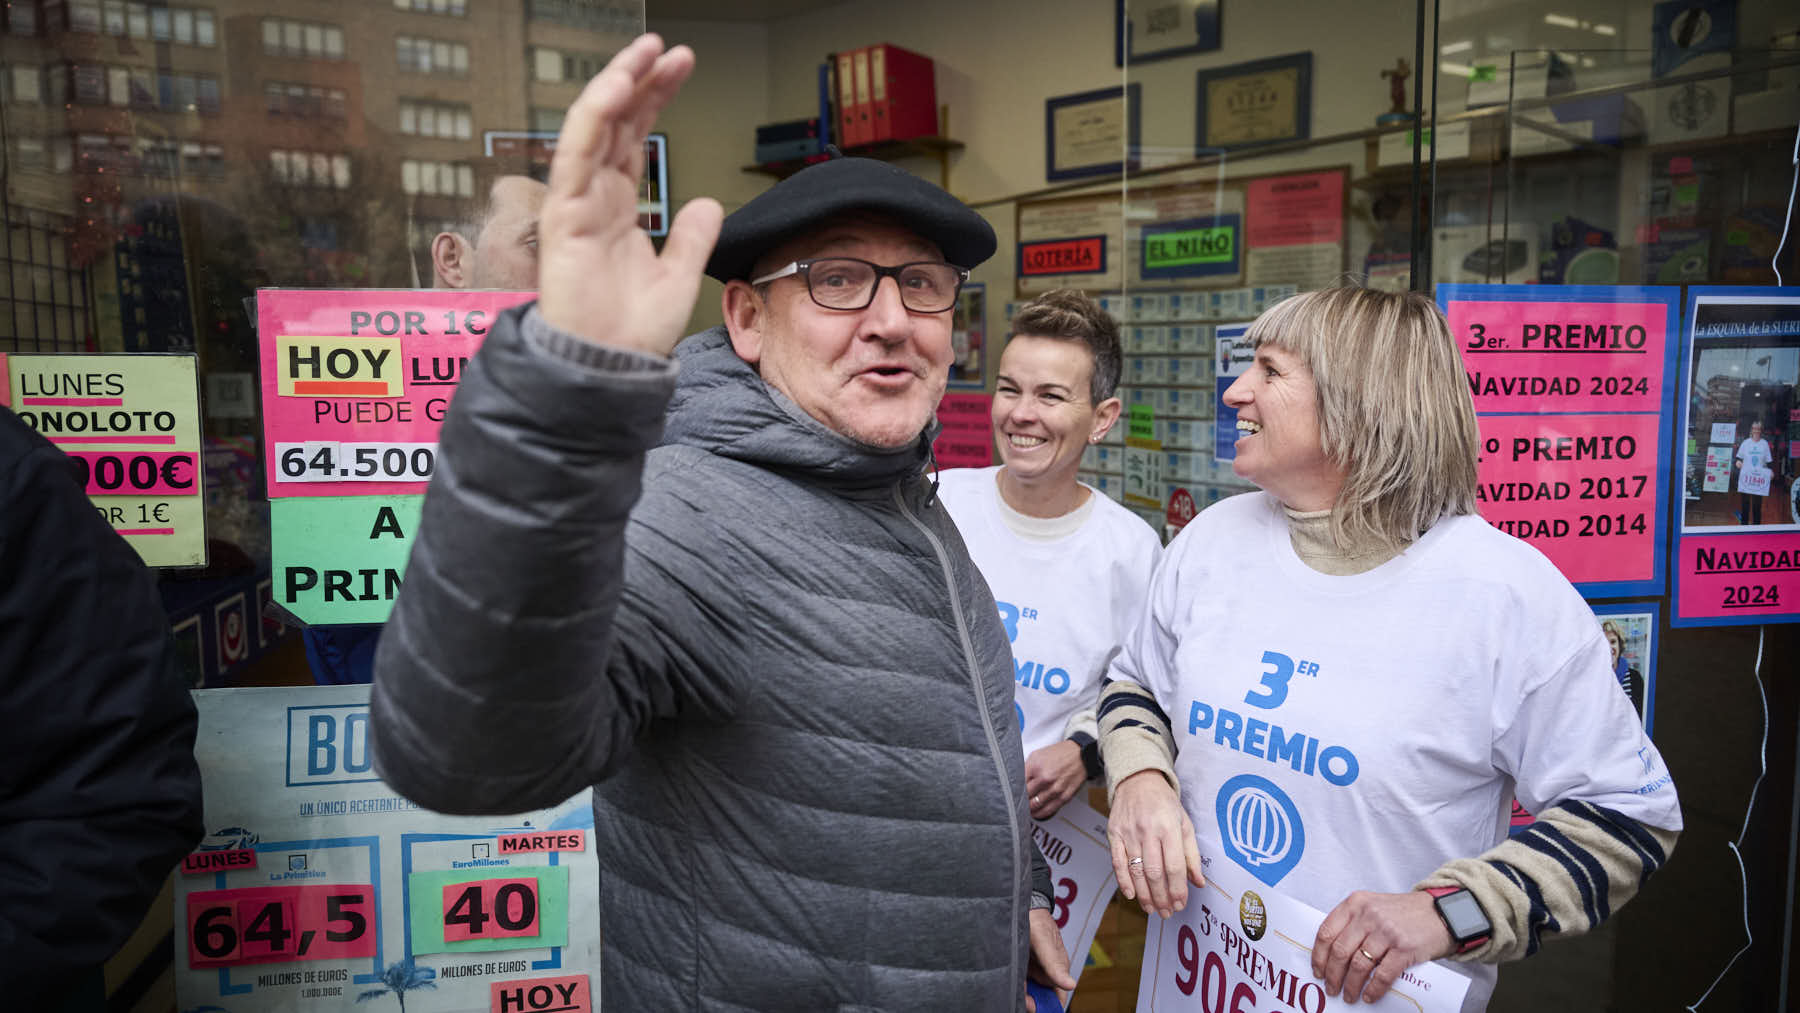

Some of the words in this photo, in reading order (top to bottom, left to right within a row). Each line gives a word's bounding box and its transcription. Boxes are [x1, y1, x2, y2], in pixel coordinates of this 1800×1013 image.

[1149, 240, 1168, 257] EL
[351, 311, 427, 336] POR
[444, 311, 486, 335] 1€
[1707, 321, 1746, 337] ESQUINA
[1771, 319, 1800, 334] SUERT
[1468, 324, 1510, 348] 3er.
[1522, 324, 1647, 349] PREMIO
[289, 346, 391, 379] HOY
[21, 373, 125, 396] LUNES
[1467, 372, 1581, 396] NAVIDAD
[1590, 377, 1649, 396] 2024
[17, 411, 176, 432] ONOLOTO
[315, 400, 412, 424] PUEDE
[1512, 436, 1636, 462] PREMIO
[281, 447, 434, 477] 64.500
[1476, 482, 1571, 502] AVIDAD
[1579, 475, 1647, 500] 2017
[138, 503, 170, 523] 1€
[370, 507, 404, 539] A
[1578, 514, 1647, 537] 2014
[1723, 585, 1779, 605] 2024
[1013, 658, 1070, 695] MIO
[1189, 700, 1359, 787] PREMIO
[300, 803, 314, 816] UN
[317, 800, 347, 815] ÚNICO
[503, 835, 579, 851] MARTES
[1031, 823, 1073, 866] EMIO
[185, 852, 251, 870] LUNES
[452, 858, 510, 869] EuroMillones
[445, 883, 536, 934] 40
[194, 895, 366, 958] 64,5
[258, 972, 302, 987] MILLONES
[304, 971, 316, 984] DE
[318, 969, 348, 983] EUROS
[441, 964, 483, 979] MILLONES
[486, 963, 496, 974] DE
[498, 960, 527, 974] EUROS
[1220, 922, 1326, 1013] PREMIO
[500, 983, 578, 1013] HOY
